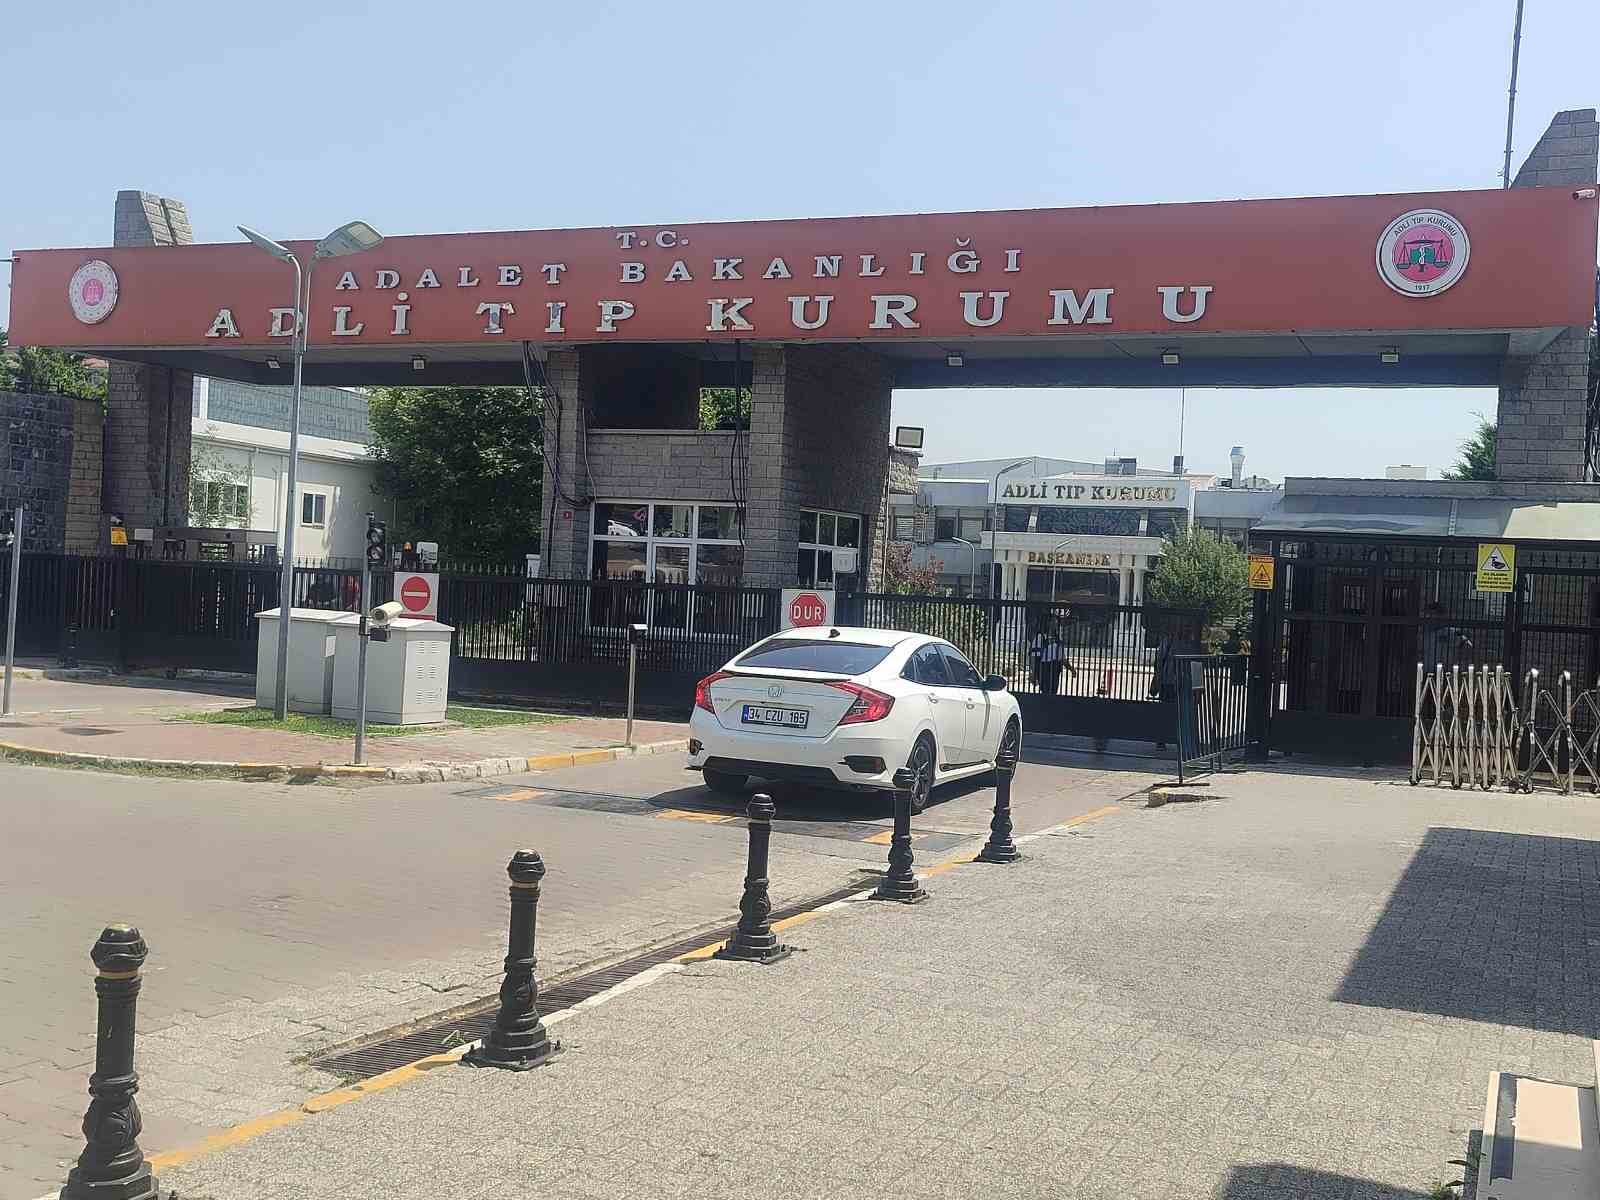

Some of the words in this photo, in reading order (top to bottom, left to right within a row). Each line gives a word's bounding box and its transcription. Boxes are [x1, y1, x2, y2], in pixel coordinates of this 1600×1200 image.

[615, 231, 690, 249] T.C.
[335, 263, 568, 290] ADALET
[618, 237, 1022, 284] BAKANLIĞI
[204, 292, 411, 338] ADLİ
[475, 299, 636, 334] TIP
[705, 286, 1213, 332] KURUMU
[1003, 482, 1048, 499] ADLİ
[1054, 484, 1086, 500] TIP
[793, 604, 822, 621] DUR
[748, 708, 760, 719] 34
[765, 709, 783, 722] CZU
